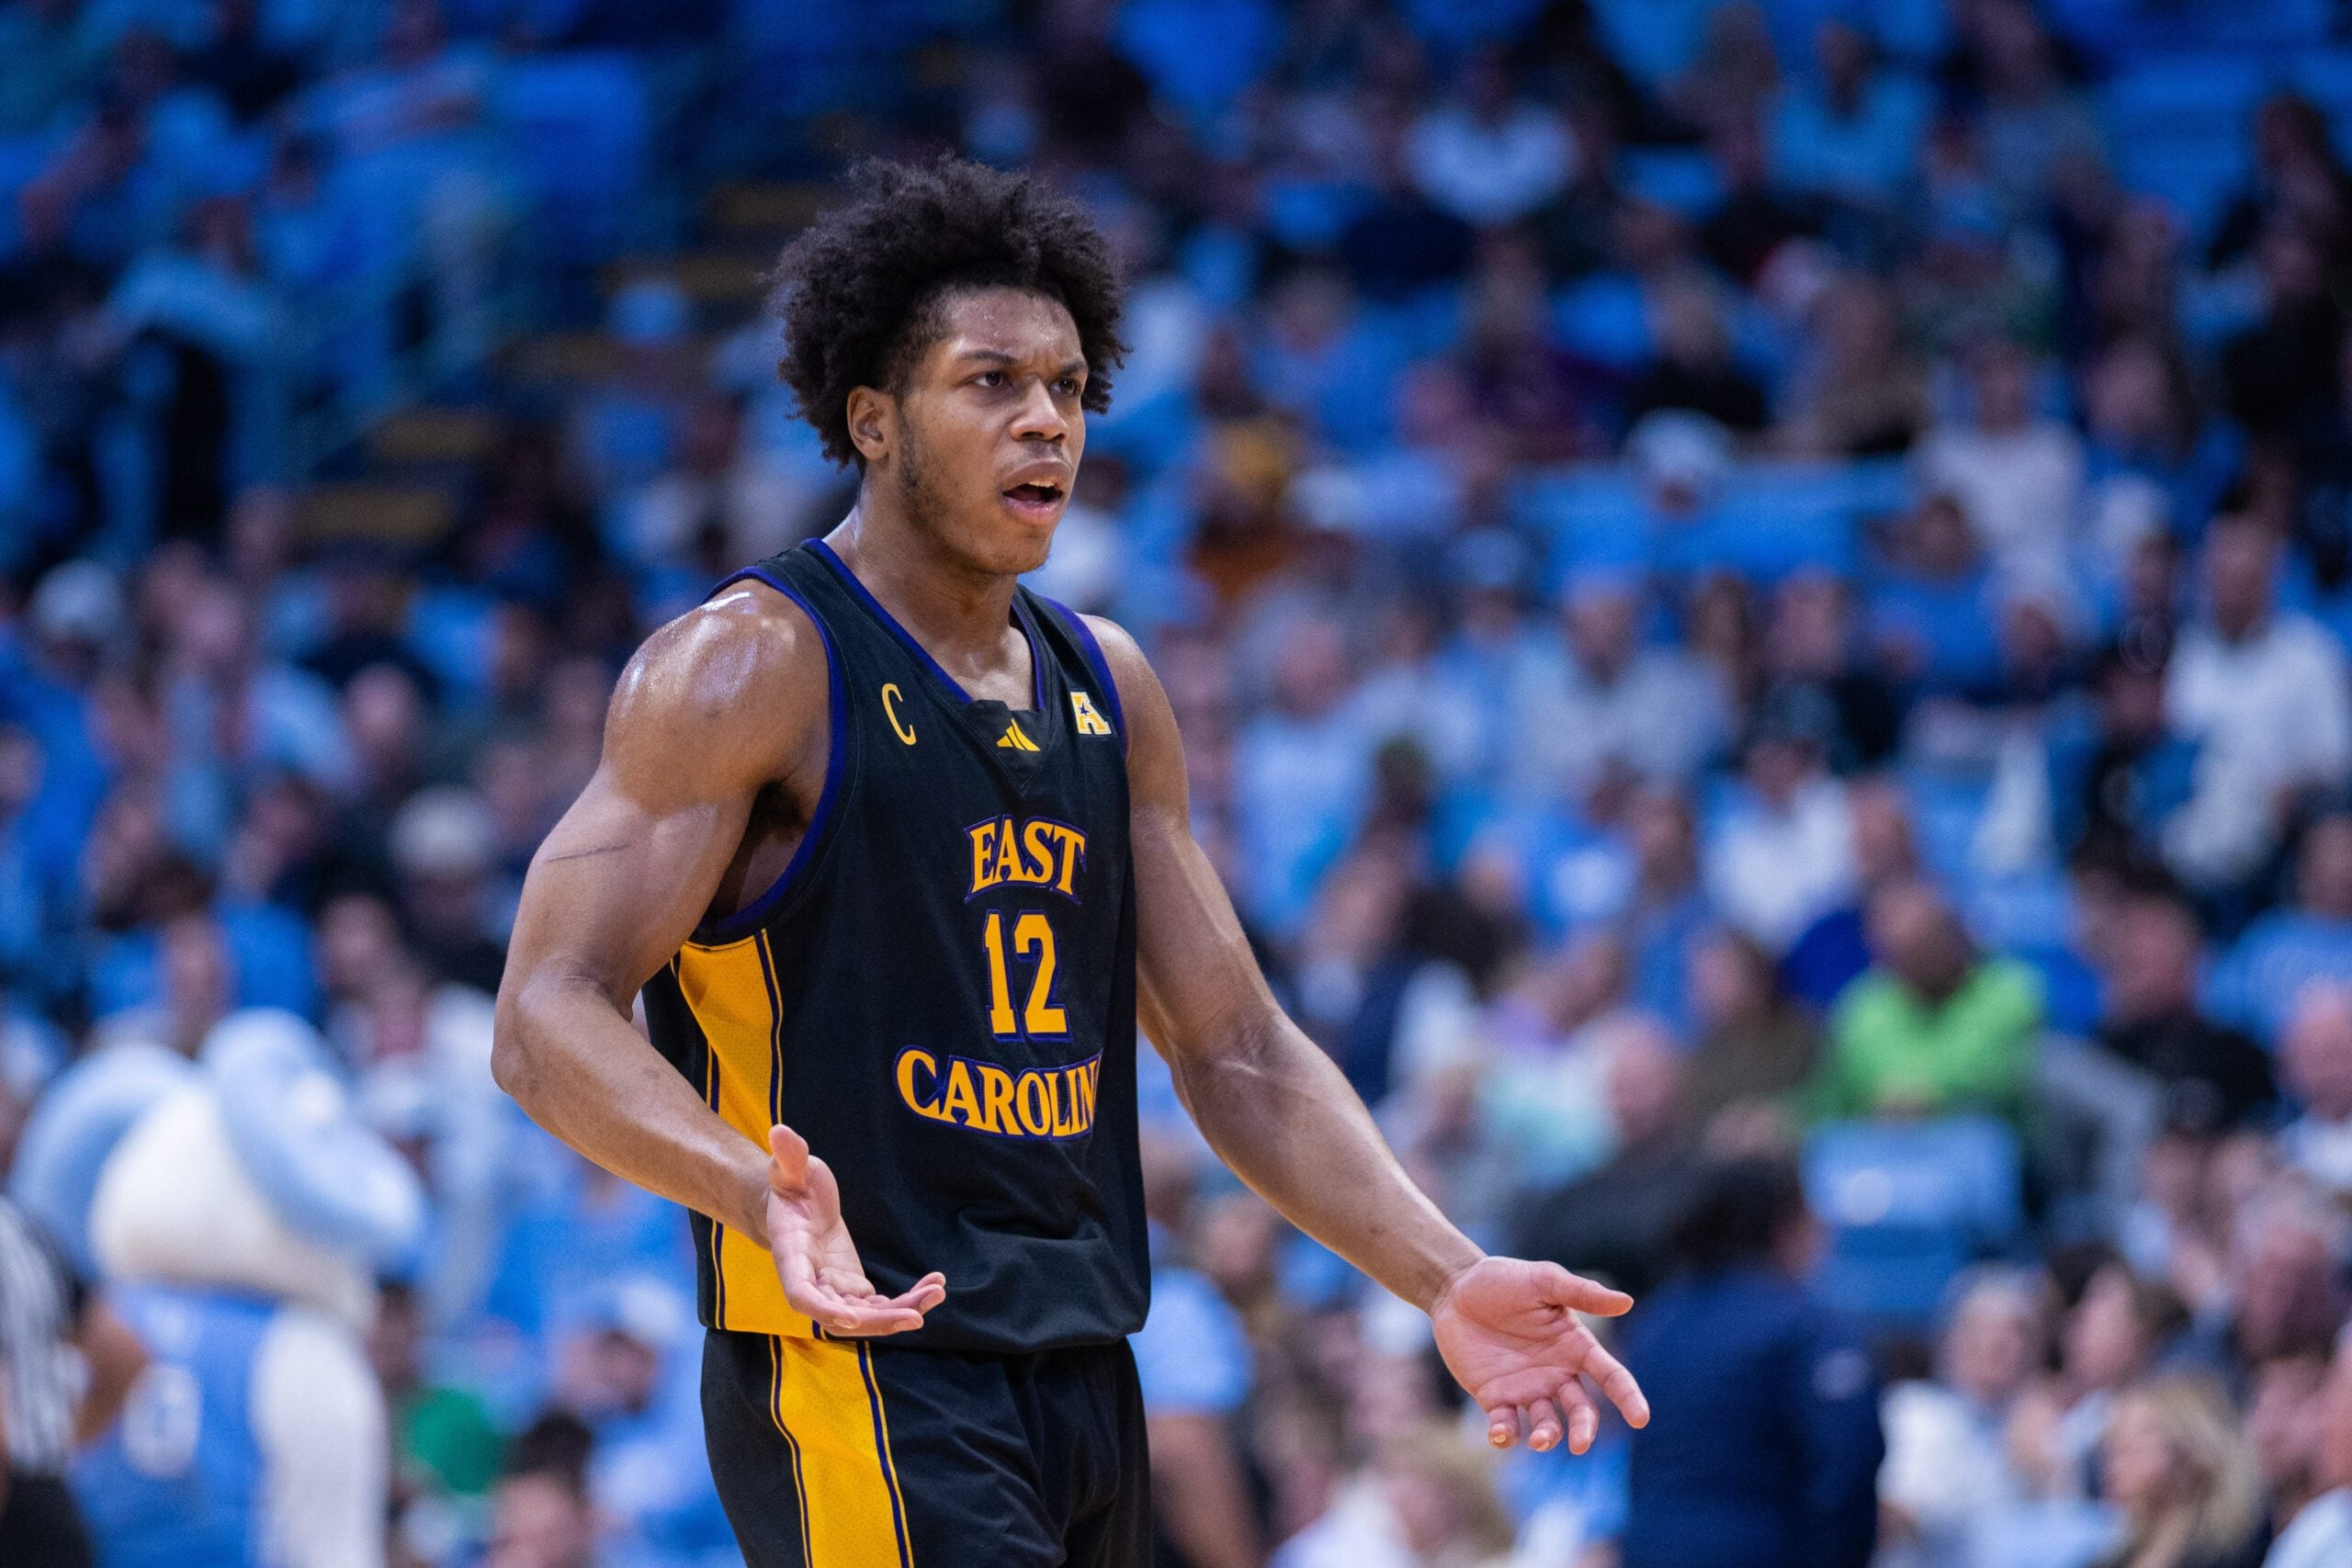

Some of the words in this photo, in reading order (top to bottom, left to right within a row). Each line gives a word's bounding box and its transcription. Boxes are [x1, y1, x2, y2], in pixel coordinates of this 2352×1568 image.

[881, 682, 917, 746] C
[966, 815, 1087, 902] EAST
[982, 909, 1072, 1042] 12
[895, 1045, 1102, 1140] CAROLIN
